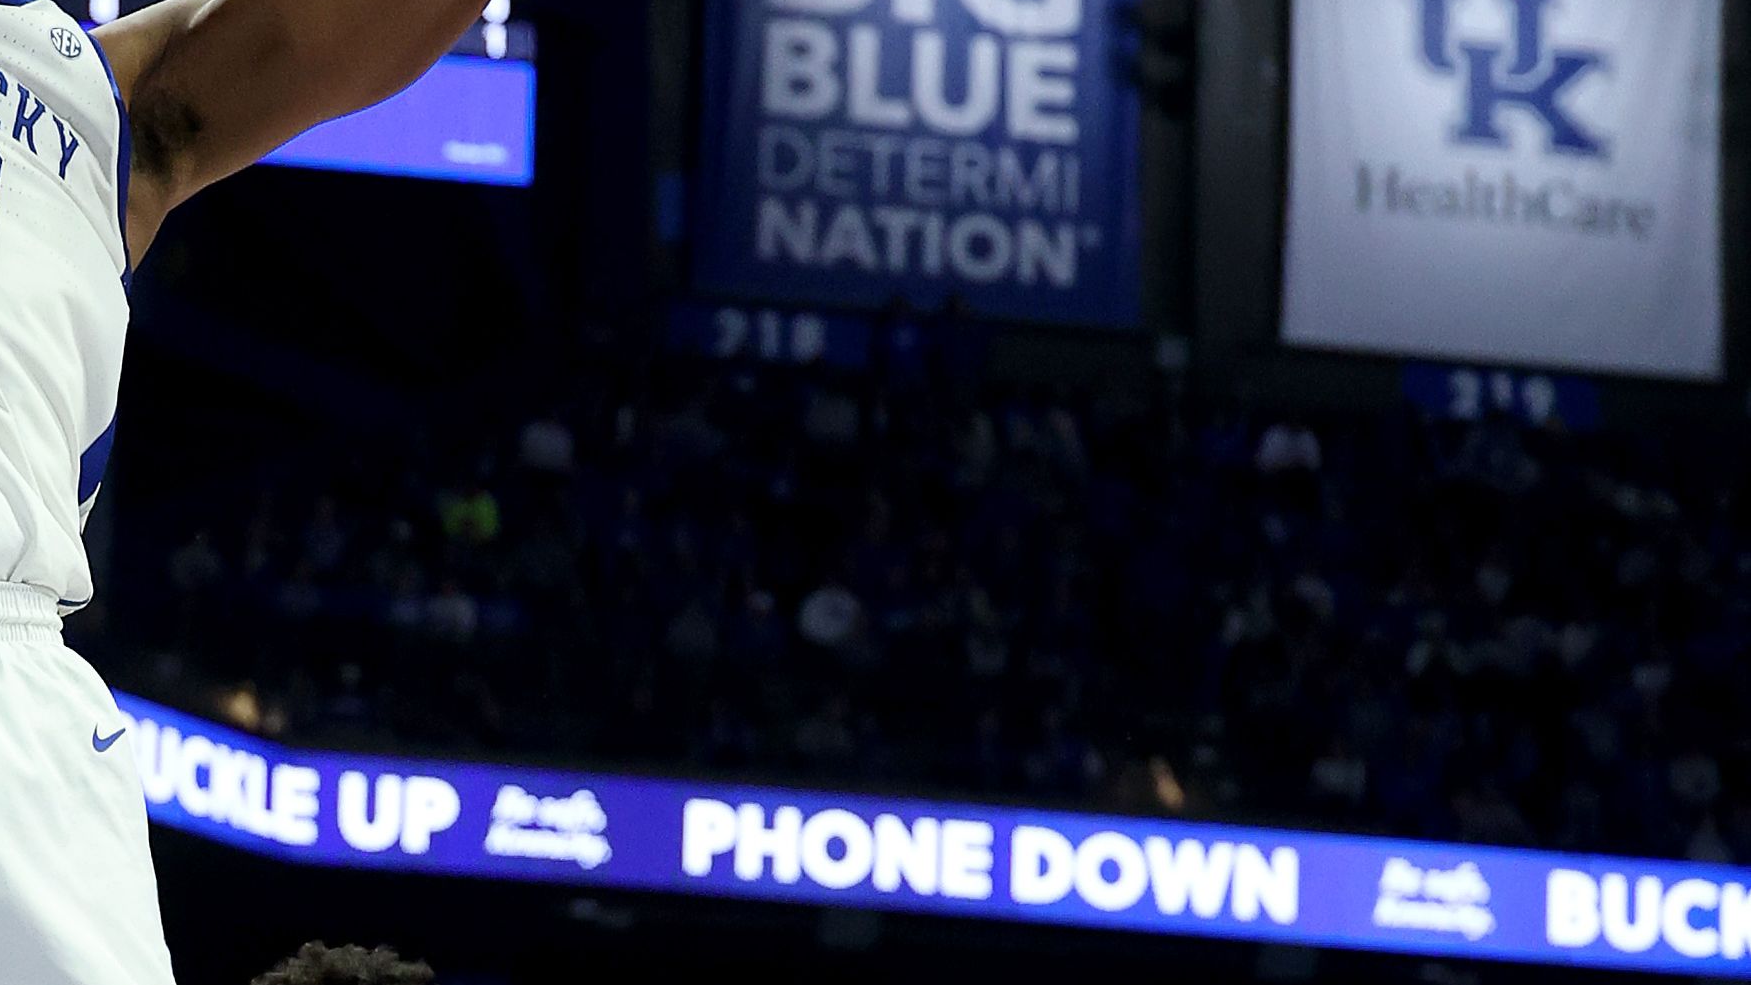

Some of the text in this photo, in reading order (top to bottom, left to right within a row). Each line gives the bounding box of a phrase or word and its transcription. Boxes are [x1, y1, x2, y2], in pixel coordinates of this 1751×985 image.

[51, 28, 81, 57] SEC
[761, 17, 1080, 145] BLUE
[757, 124, 1080, 214] DETERMI
[1353, 162, 1657, 239] HealthCare
[120, 711, 321, 846] UCKLE
[336, 771, 462, 855] UP
[681, 797, 995, 899] PHONE
[1009, 824, 1301, 926] DOWN
